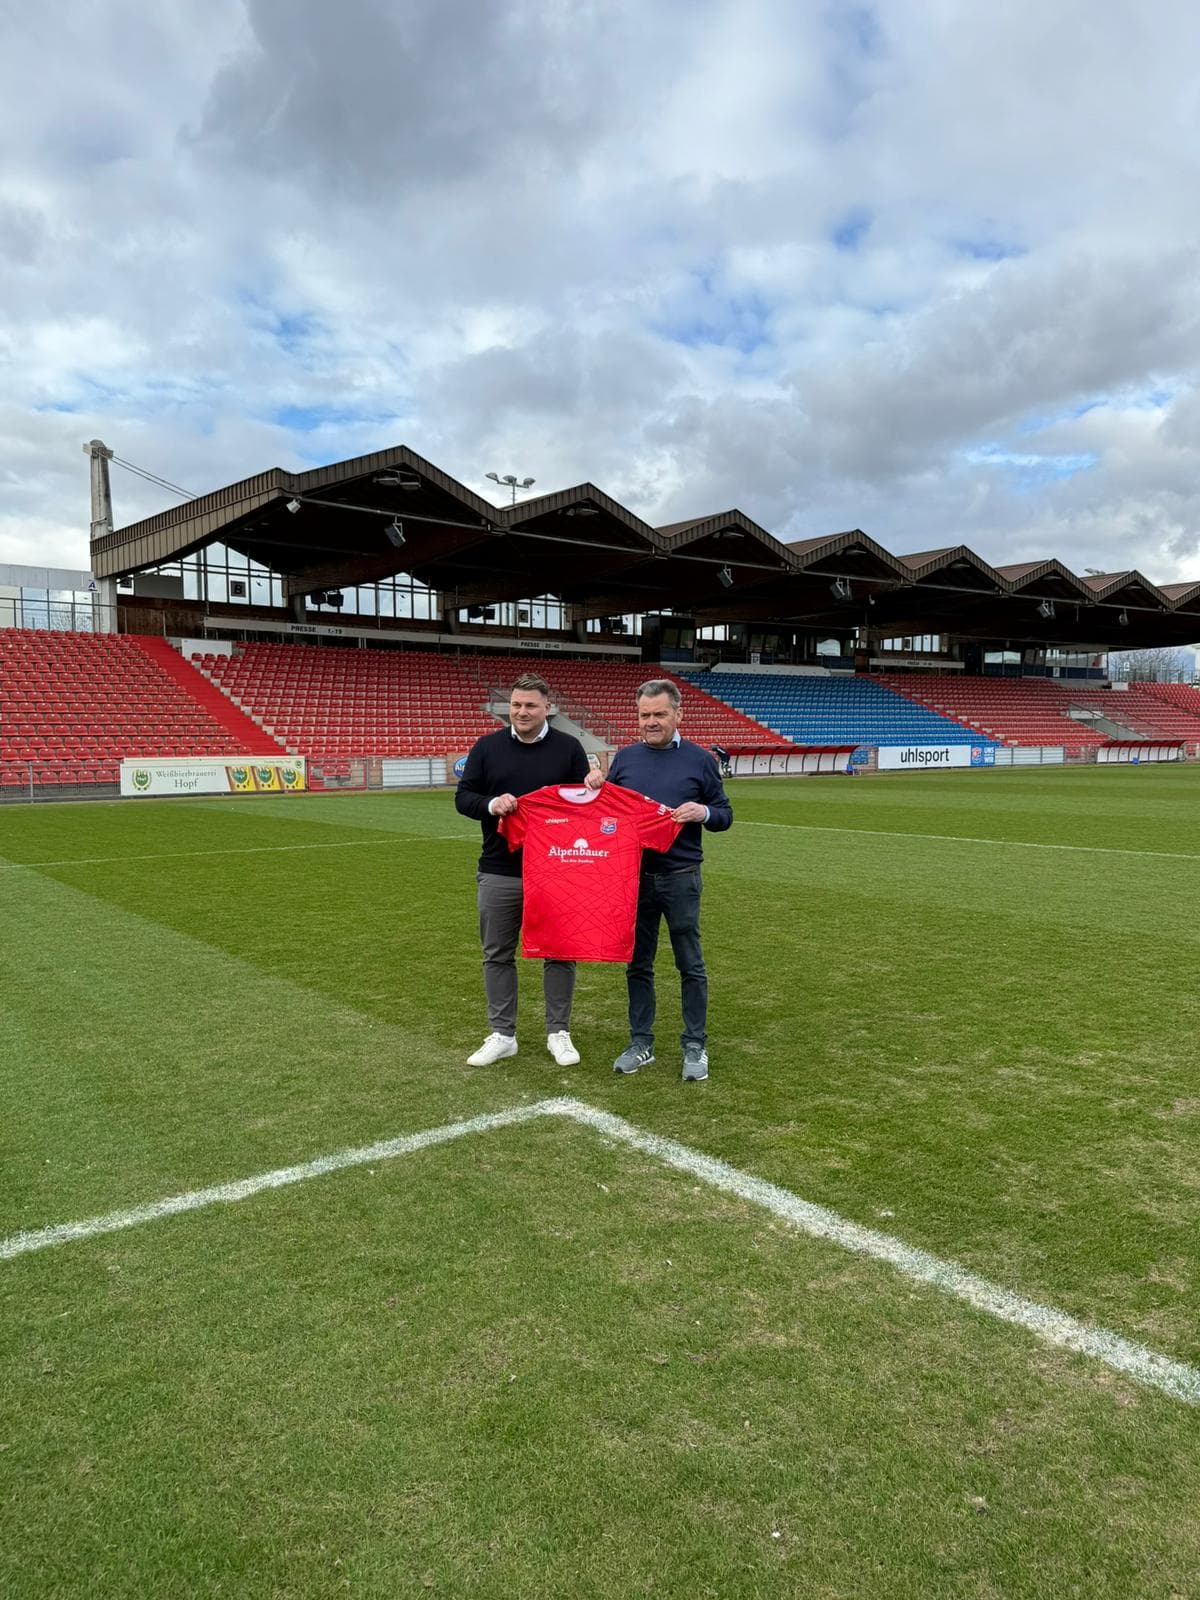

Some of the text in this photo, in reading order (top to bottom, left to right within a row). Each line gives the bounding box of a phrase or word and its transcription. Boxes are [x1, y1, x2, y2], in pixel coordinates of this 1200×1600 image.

[234, 584, 242, 595] B
[290, 624, 317, 633] PRESSE
[901, 747, 950, 765] uhlsport
[175, 778, 199, 789] Hopf
[548, 845, 609, 859] Alpenbauer
